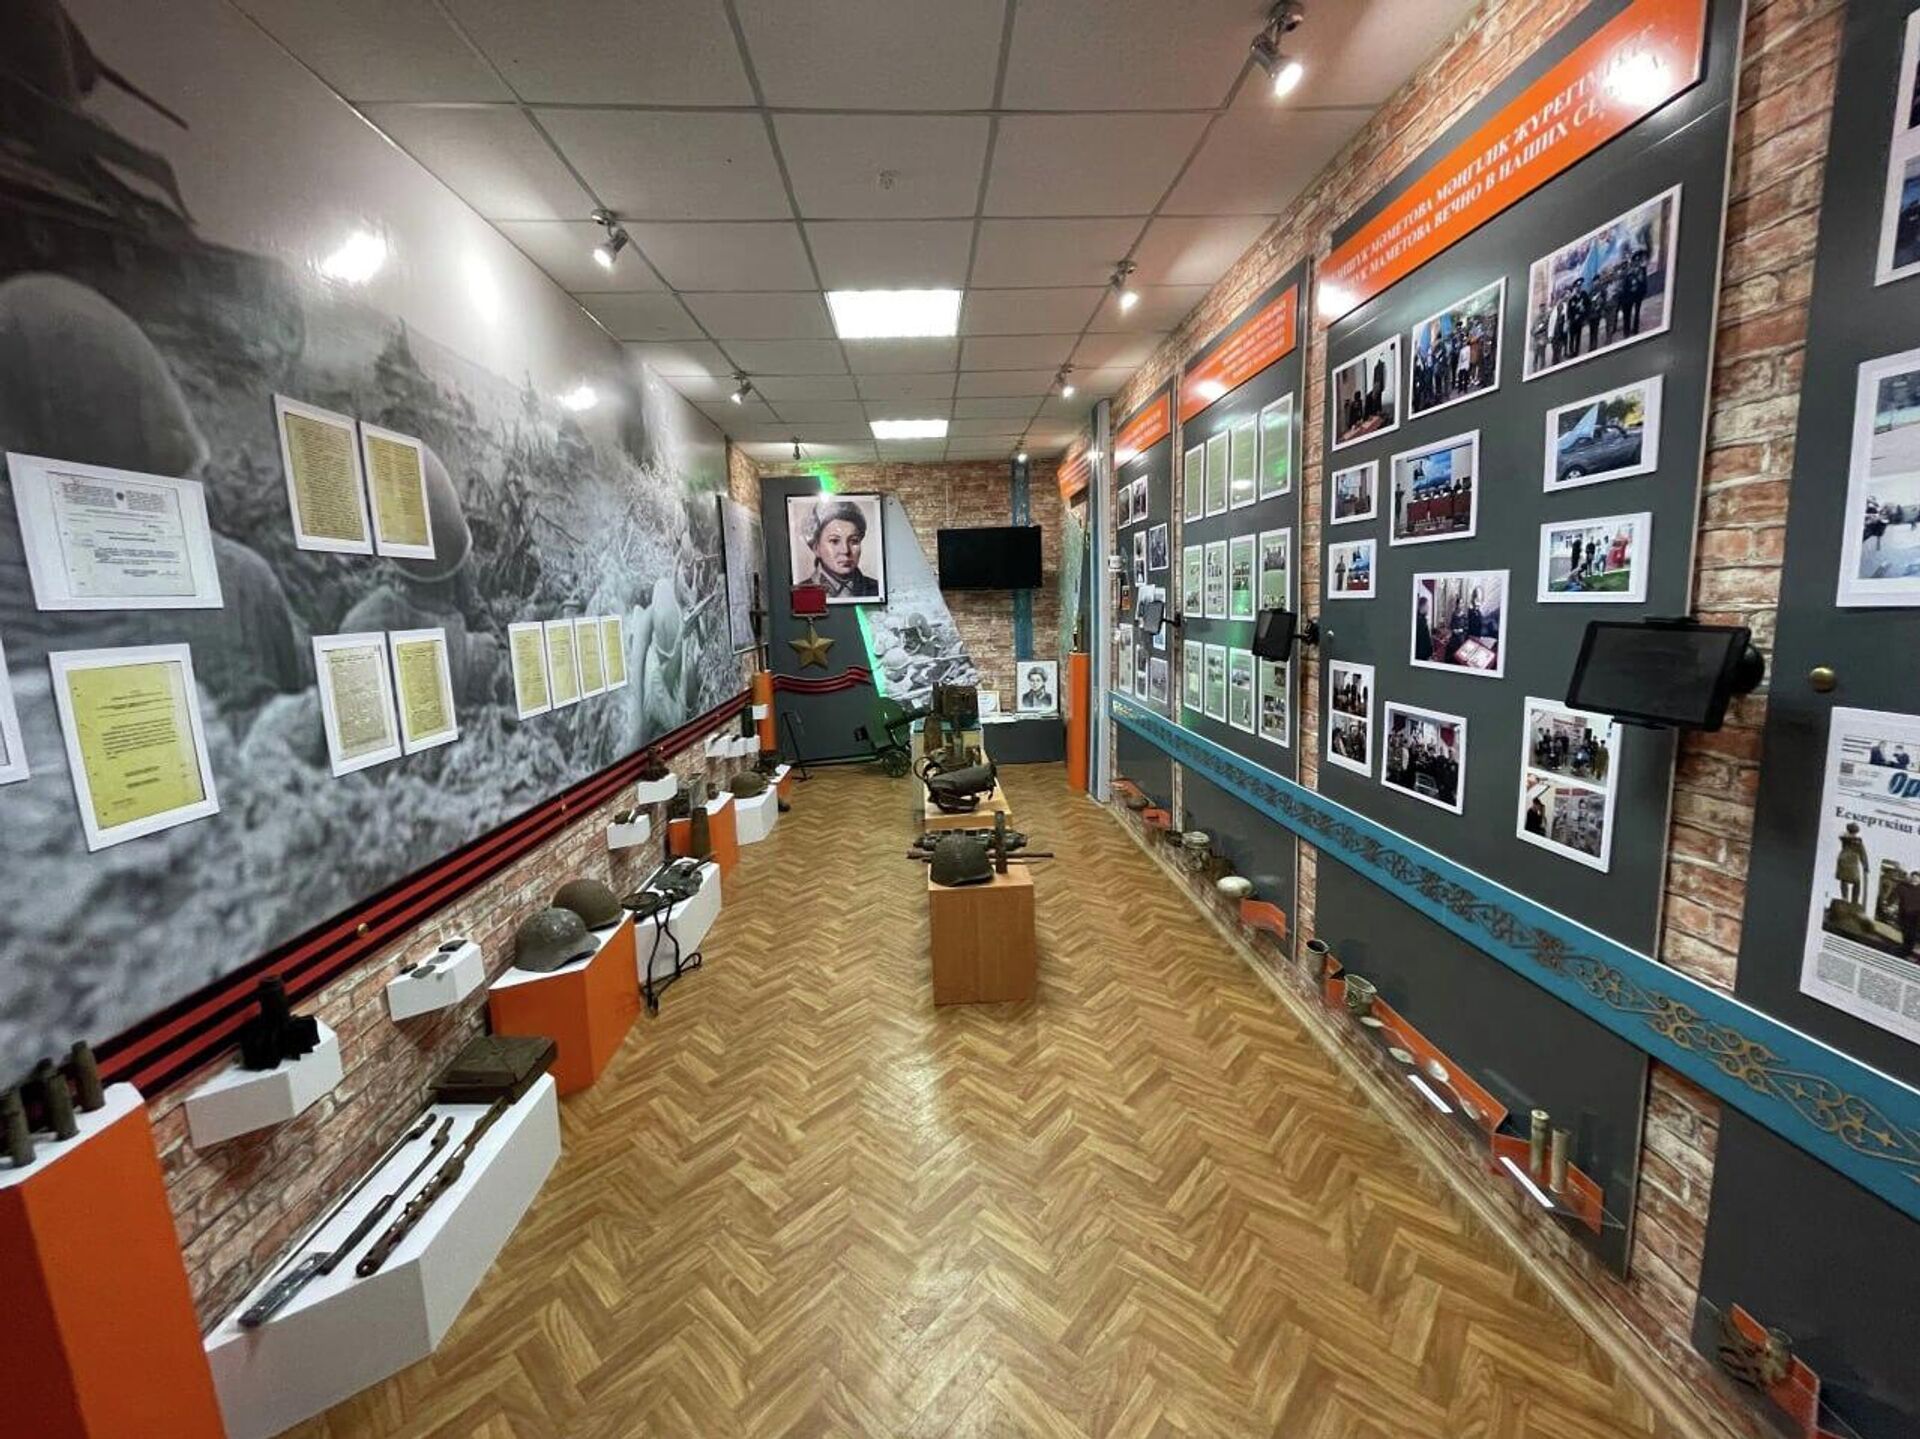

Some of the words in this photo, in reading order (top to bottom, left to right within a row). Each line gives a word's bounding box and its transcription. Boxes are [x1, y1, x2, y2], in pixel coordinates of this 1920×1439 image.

[1370, 220, 1431, 274] МАМЕТОВА
[1434, 182, 1482, 228] ВЕЧНО
[1485, 171, 1496, 191] В
[1499, 118, 1570, 181] НАШИХ
[1835, 806, 1913, 834] Ескерткіш
